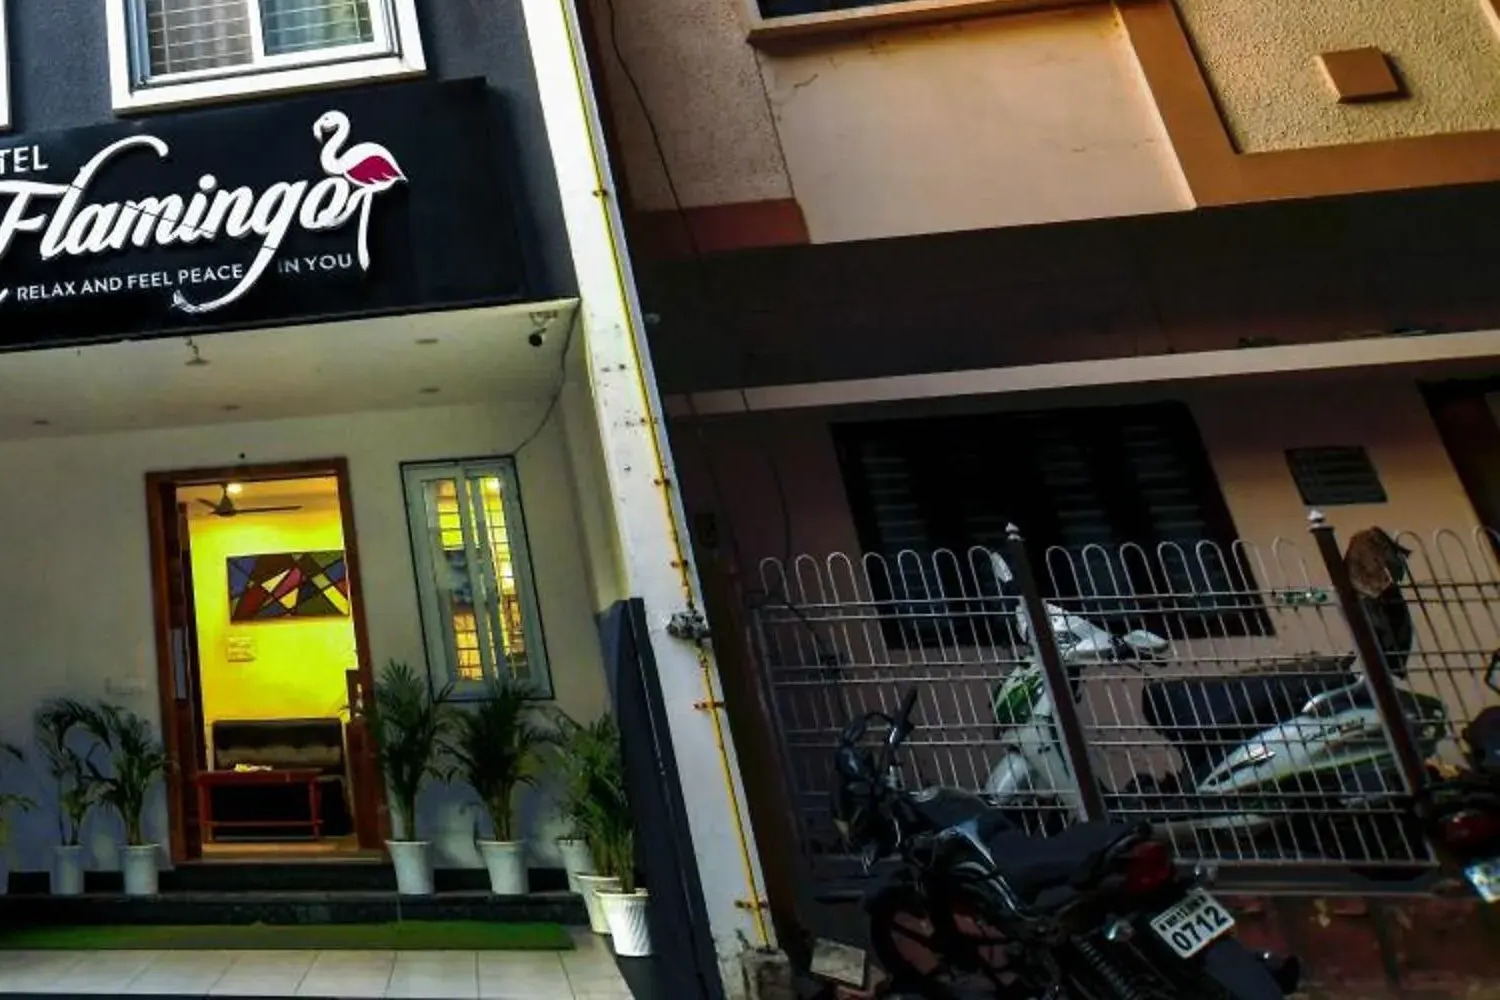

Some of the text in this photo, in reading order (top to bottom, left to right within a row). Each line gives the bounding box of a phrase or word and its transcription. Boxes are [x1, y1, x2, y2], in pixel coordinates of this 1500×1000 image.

[16, 252, 352, 302] RELAX AND FEEL PEACE IN YOU
[1171, 905, 1228, 951] 0712
